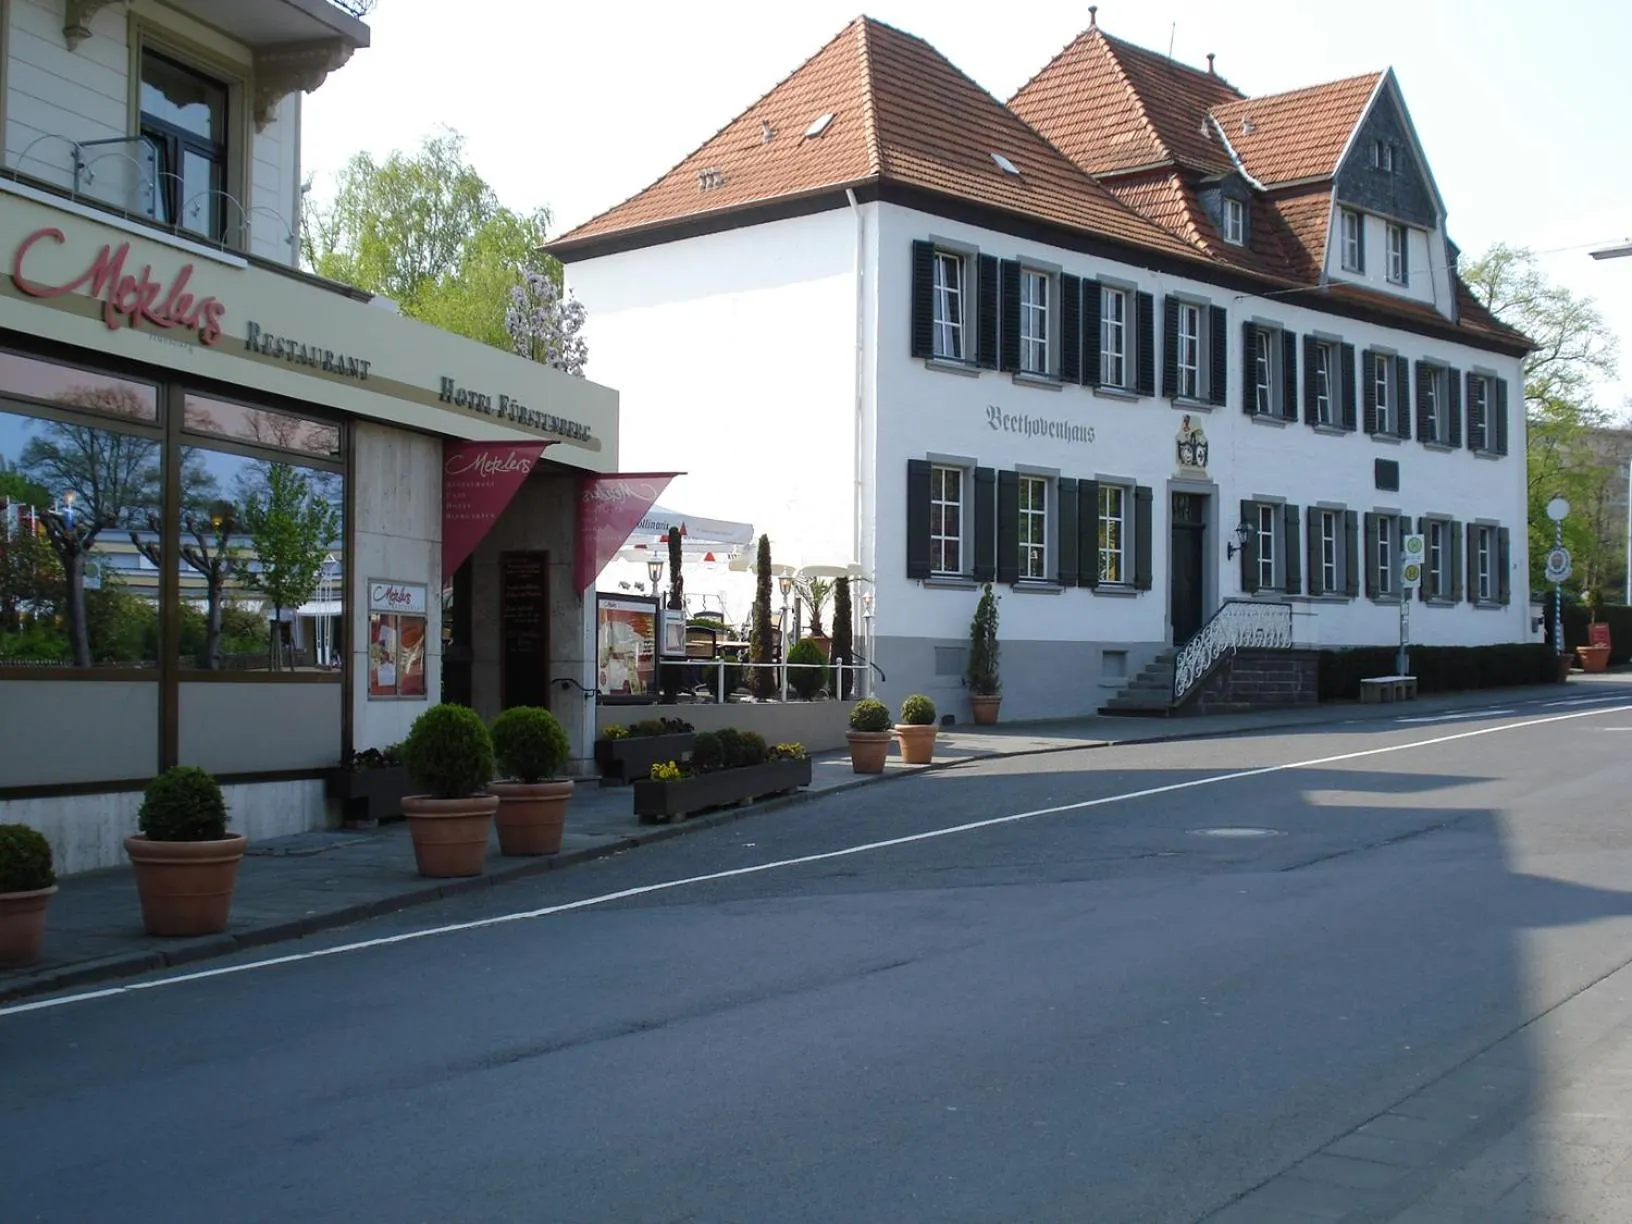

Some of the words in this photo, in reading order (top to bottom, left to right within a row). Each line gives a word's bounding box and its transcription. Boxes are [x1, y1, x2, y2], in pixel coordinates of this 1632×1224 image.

[244, 320, 371, 380] RESTAURANT
[439, 375, 493, 416] HOTEL
[985, 404, 1096, 443] Beethovenhaus
